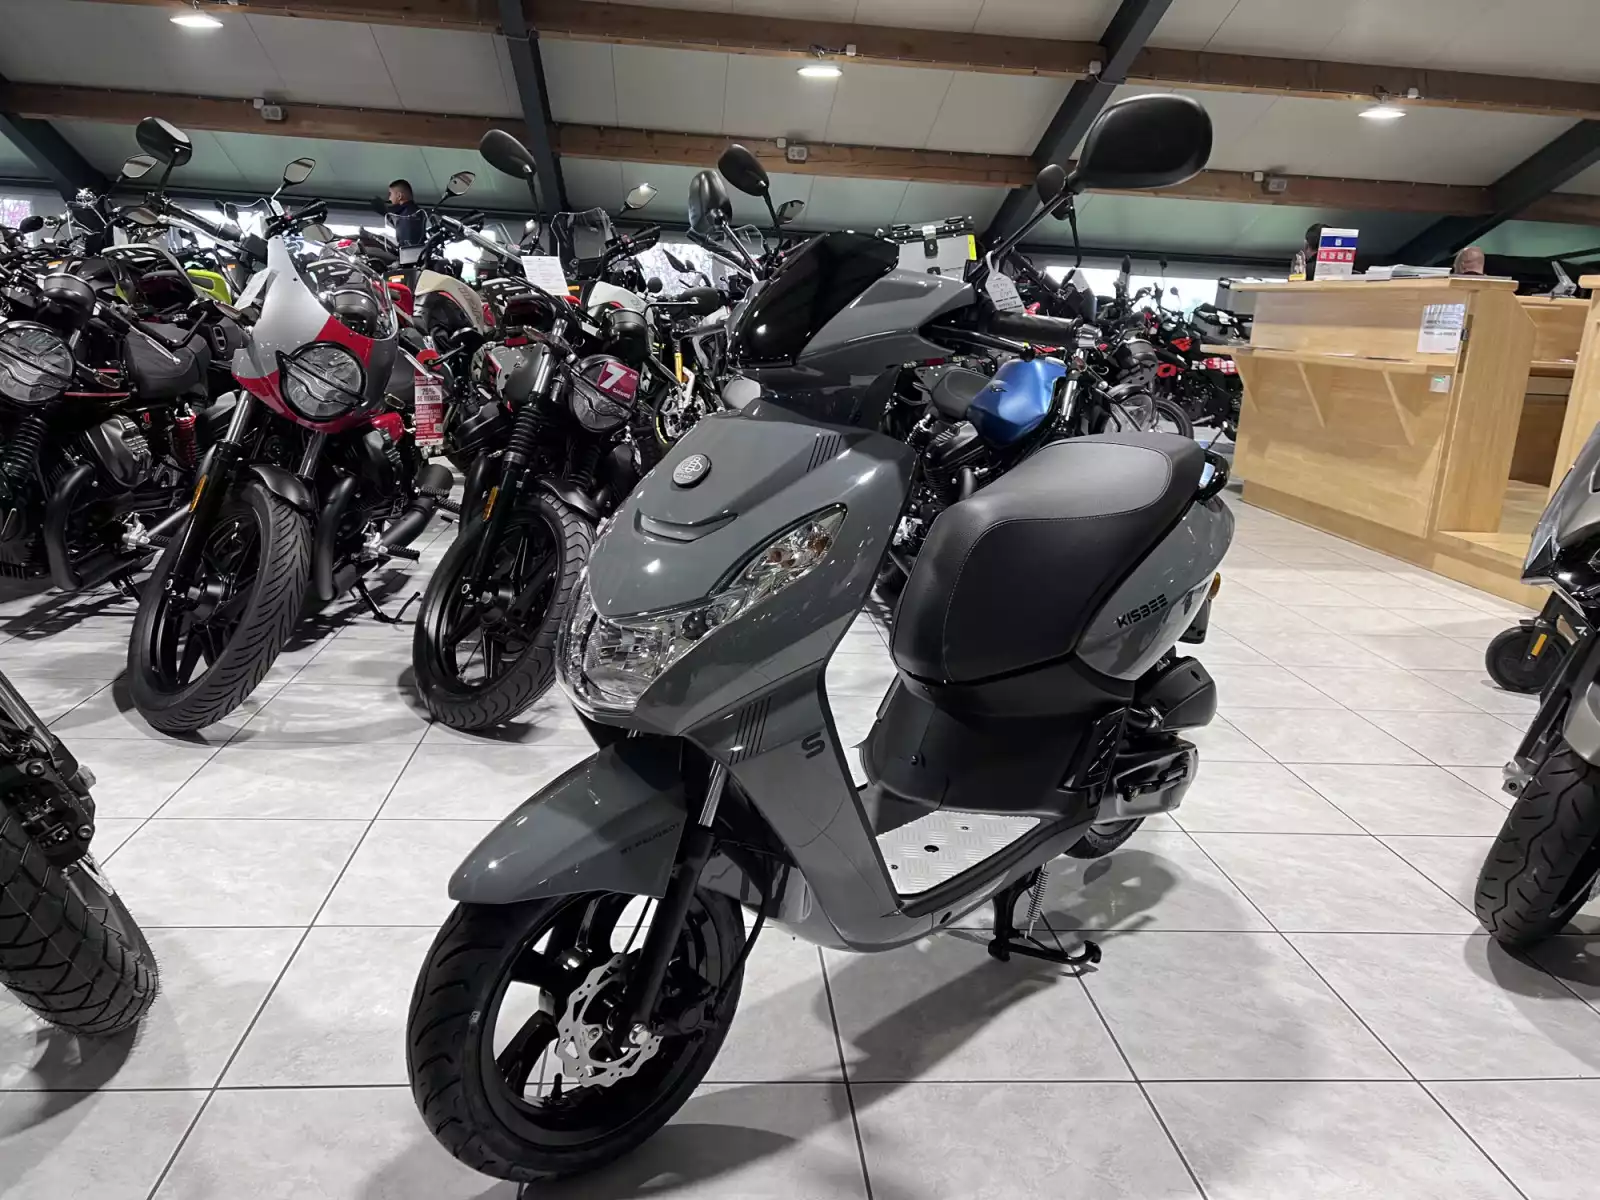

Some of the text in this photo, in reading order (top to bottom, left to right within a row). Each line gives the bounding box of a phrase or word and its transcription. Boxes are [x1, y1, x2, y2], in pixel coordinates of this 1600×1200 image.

[600, 364, 627, 389] 7
[1116, 593, 1168, 628] KISBEE
[801, 731, 825, 759] S
